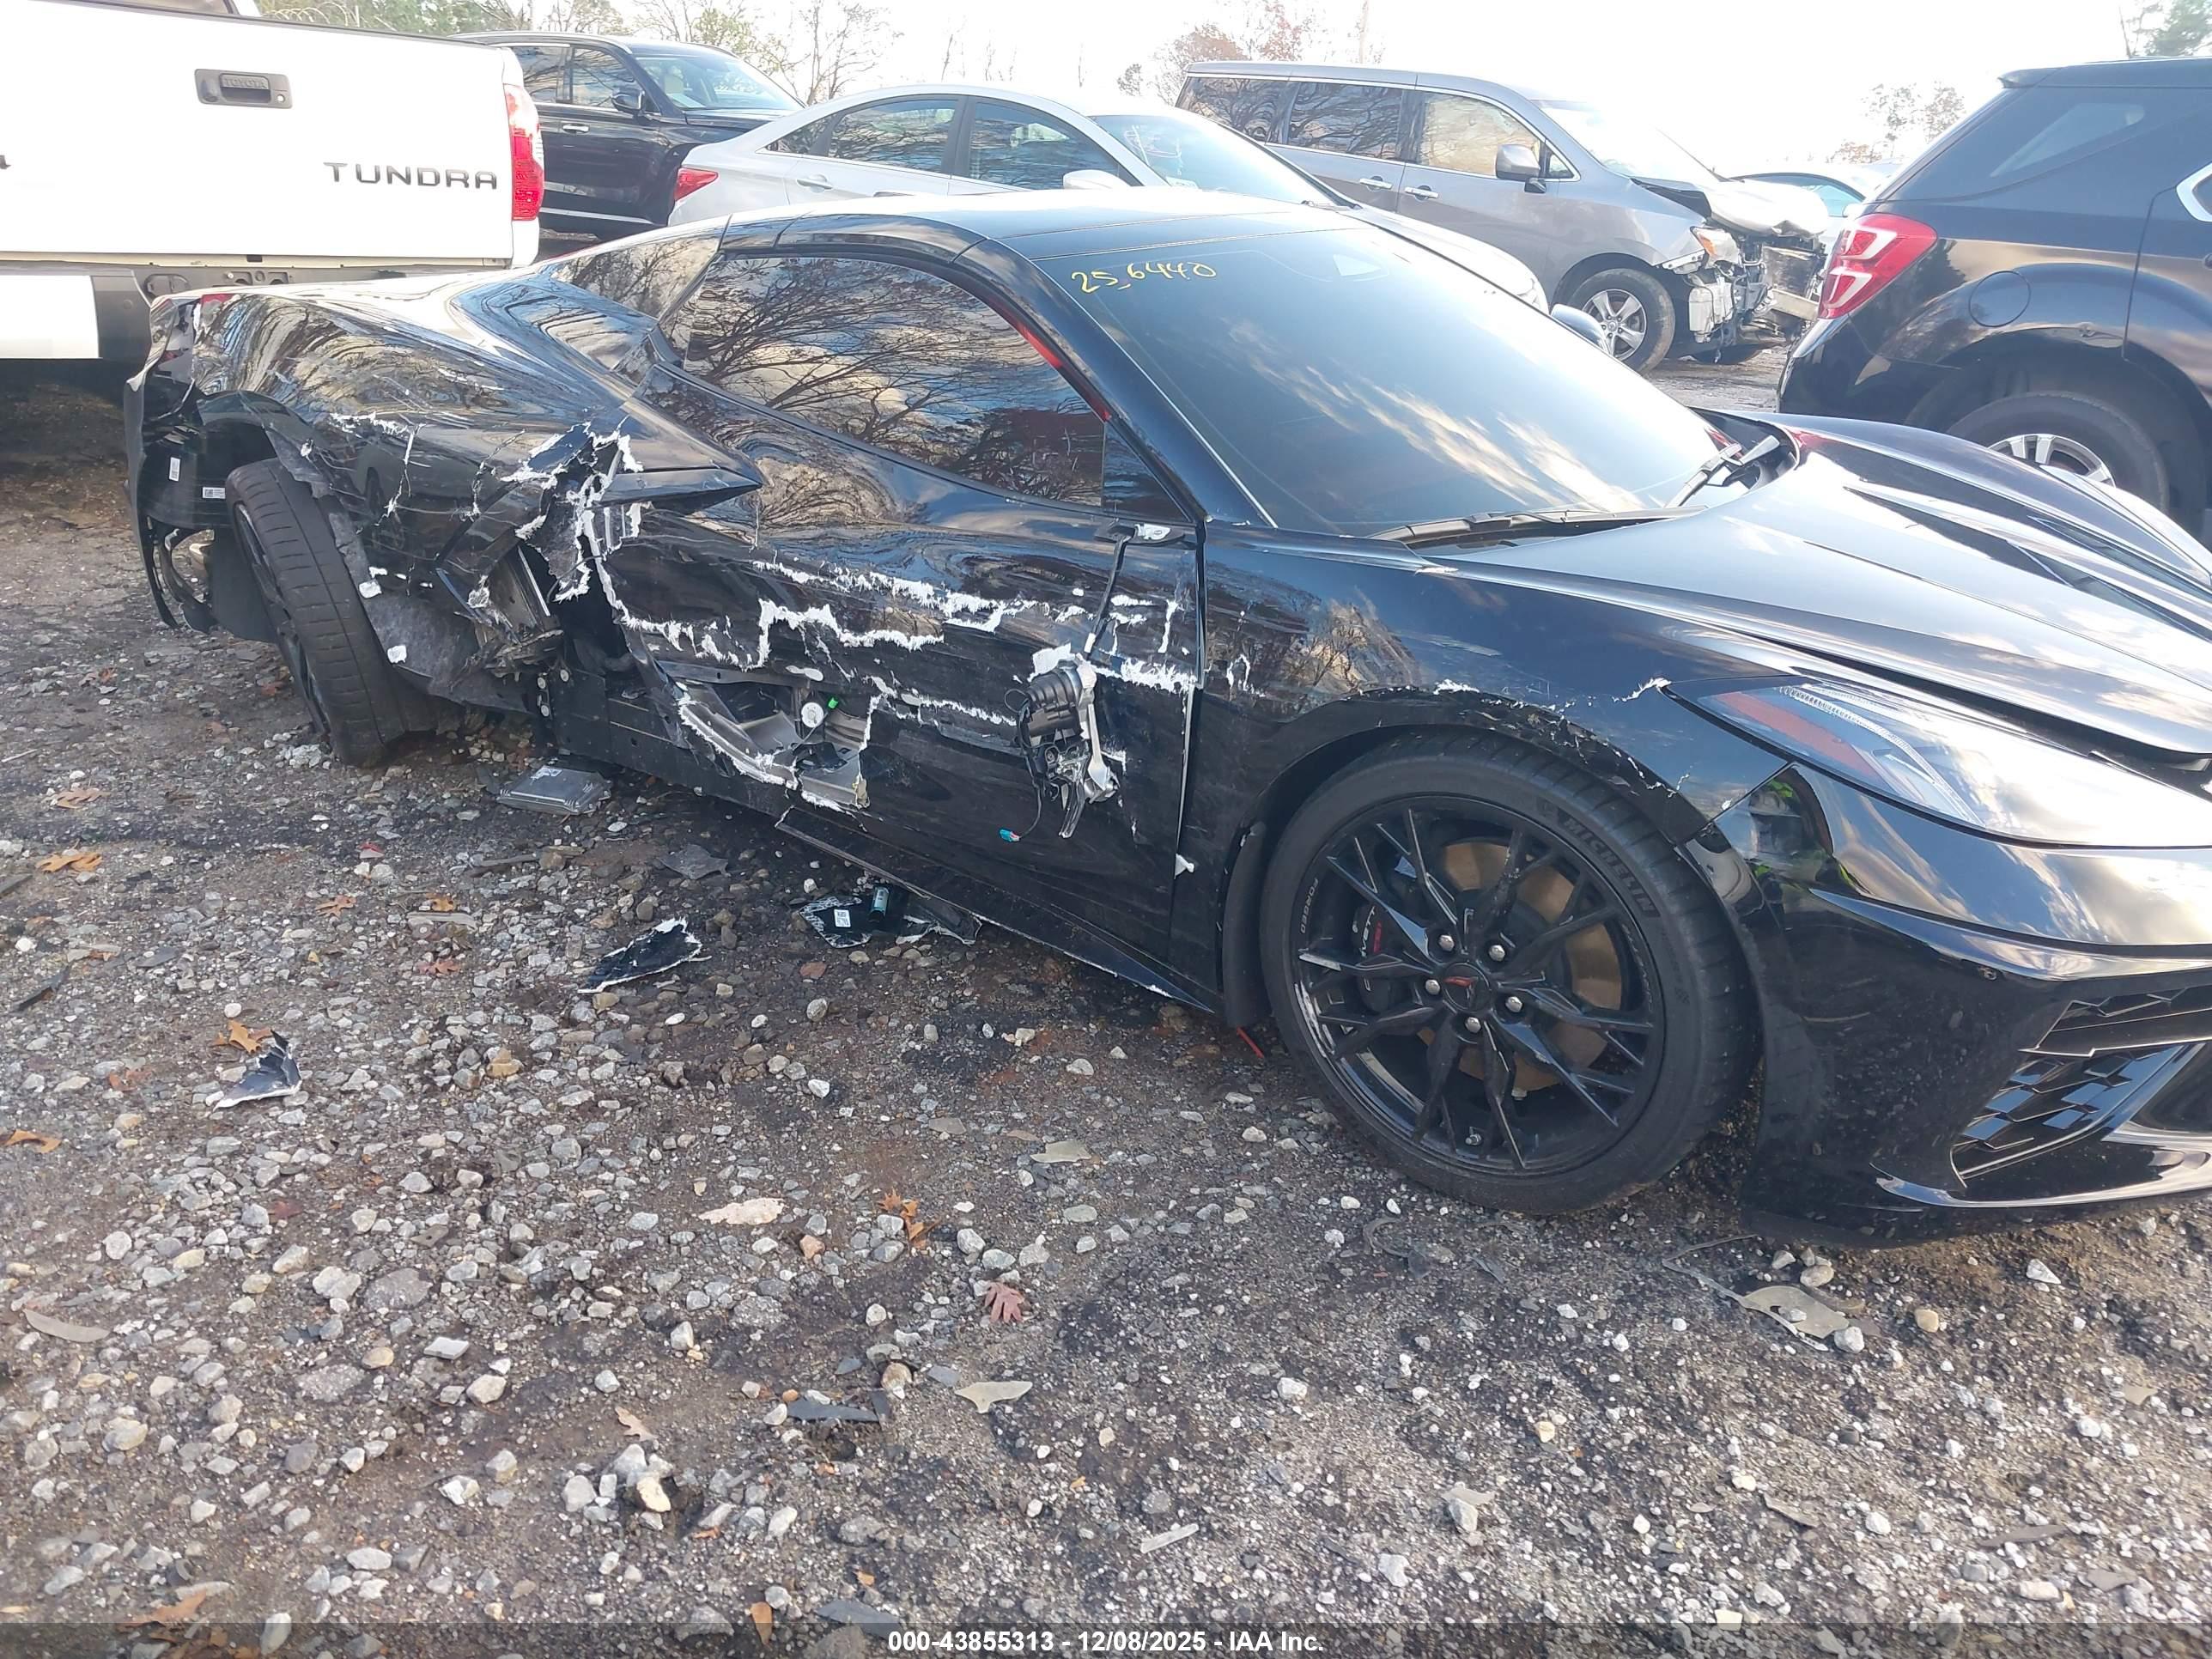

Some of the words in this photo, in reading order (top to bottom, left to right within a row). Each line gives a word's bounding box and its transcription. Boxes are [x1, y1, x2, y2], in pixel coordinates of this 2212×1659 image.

[323, 161, 497, 190] TUNDRA
[1563, 817, 1656, 913] MICHELIN
[1300, 877, 1319, 934] FORGED
